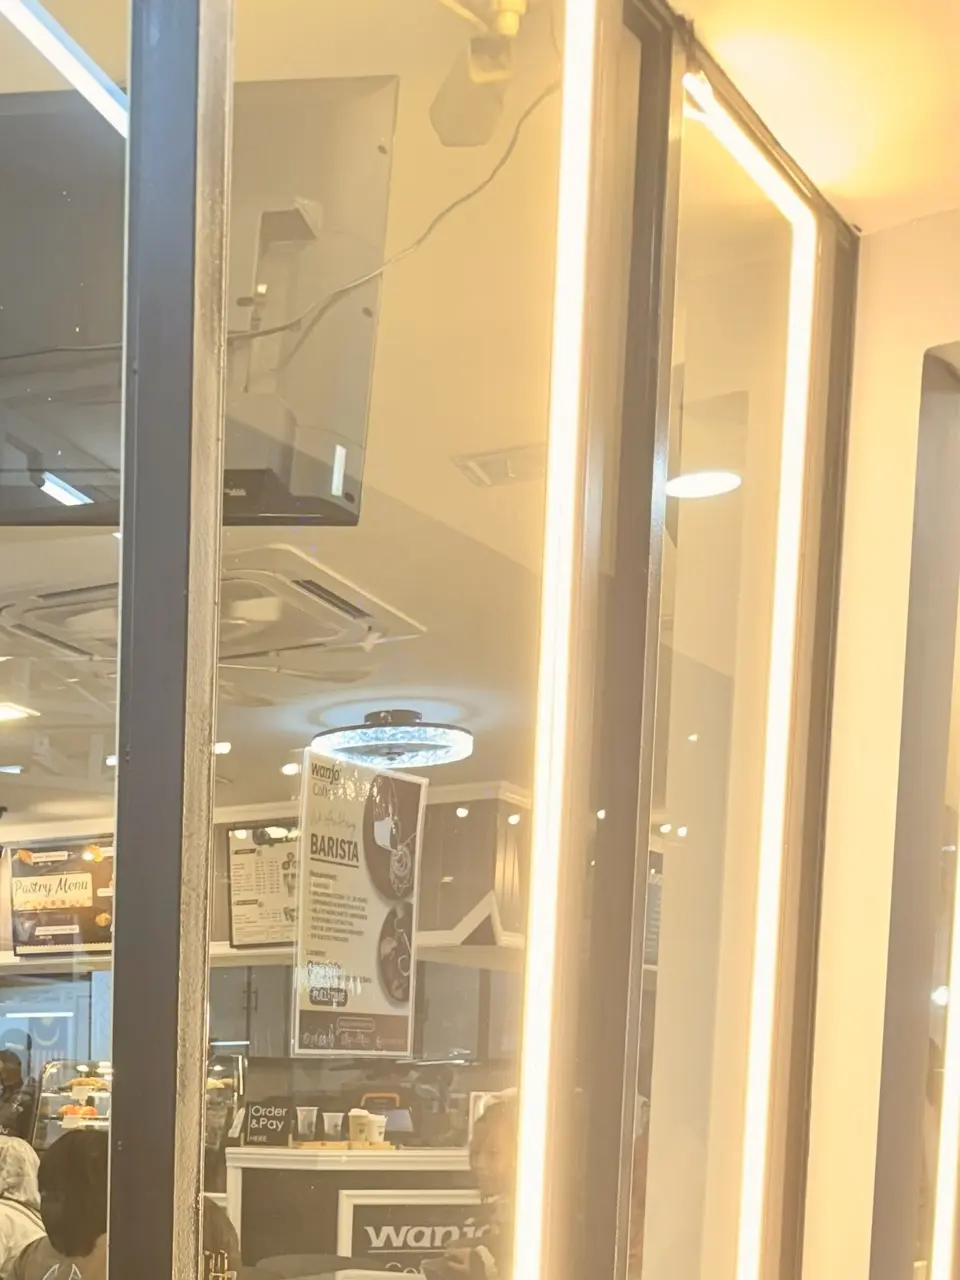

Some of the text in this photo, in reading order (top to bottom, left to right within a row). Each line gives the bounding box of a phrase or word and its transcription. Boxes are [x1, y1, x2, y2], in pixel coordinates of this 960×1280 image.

[310, 832, 359, 863] BARISTA
[14, 877, 89, 897] Pastry Menu
[251, 1105, 288, 1116] Order
[250, 1117, 284, 1132] &Pay
[364, 1217, 490, 1248] wan
